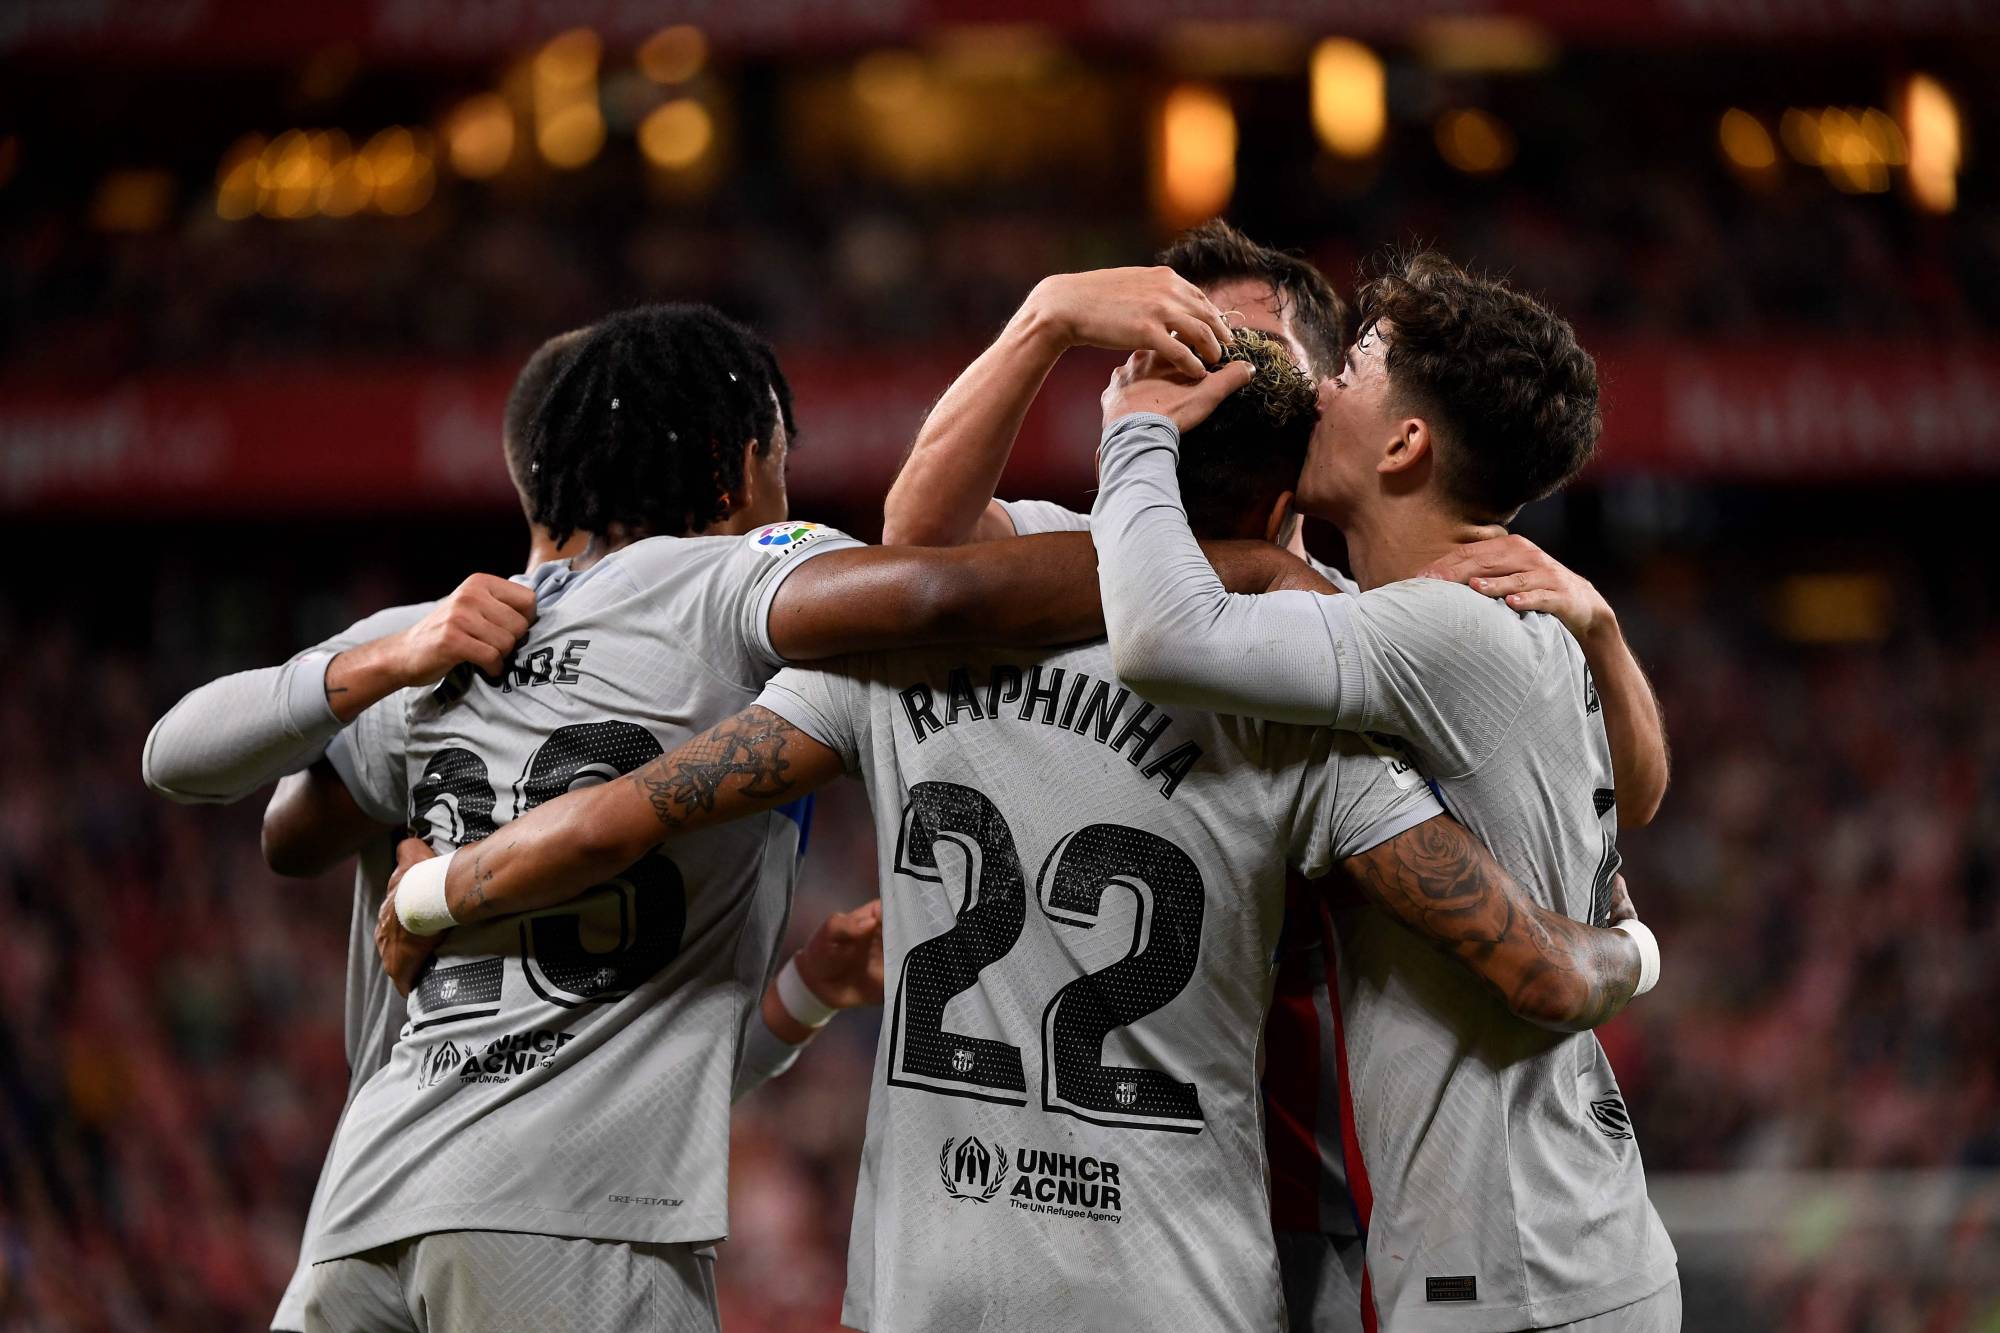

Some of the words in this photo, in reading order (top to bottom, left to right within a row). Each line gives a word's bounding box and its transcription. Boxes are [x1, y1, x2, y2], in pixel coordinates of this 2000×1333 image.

[898, 664, 1204, 801] RAPHINHA
[887, 781, 1206, 1136] 22
[1016, 1148, 1120, 1185] UNHCR
[1010, 1175, 1121, 1211] ACNUR
[1010, 1198, 1028, 1210] The
[1030, 1203, 1045, 1214] UN
[1046, 1205, 1085, 1219] Refugee
[1087, 1210, 1122, 1224] Agency
